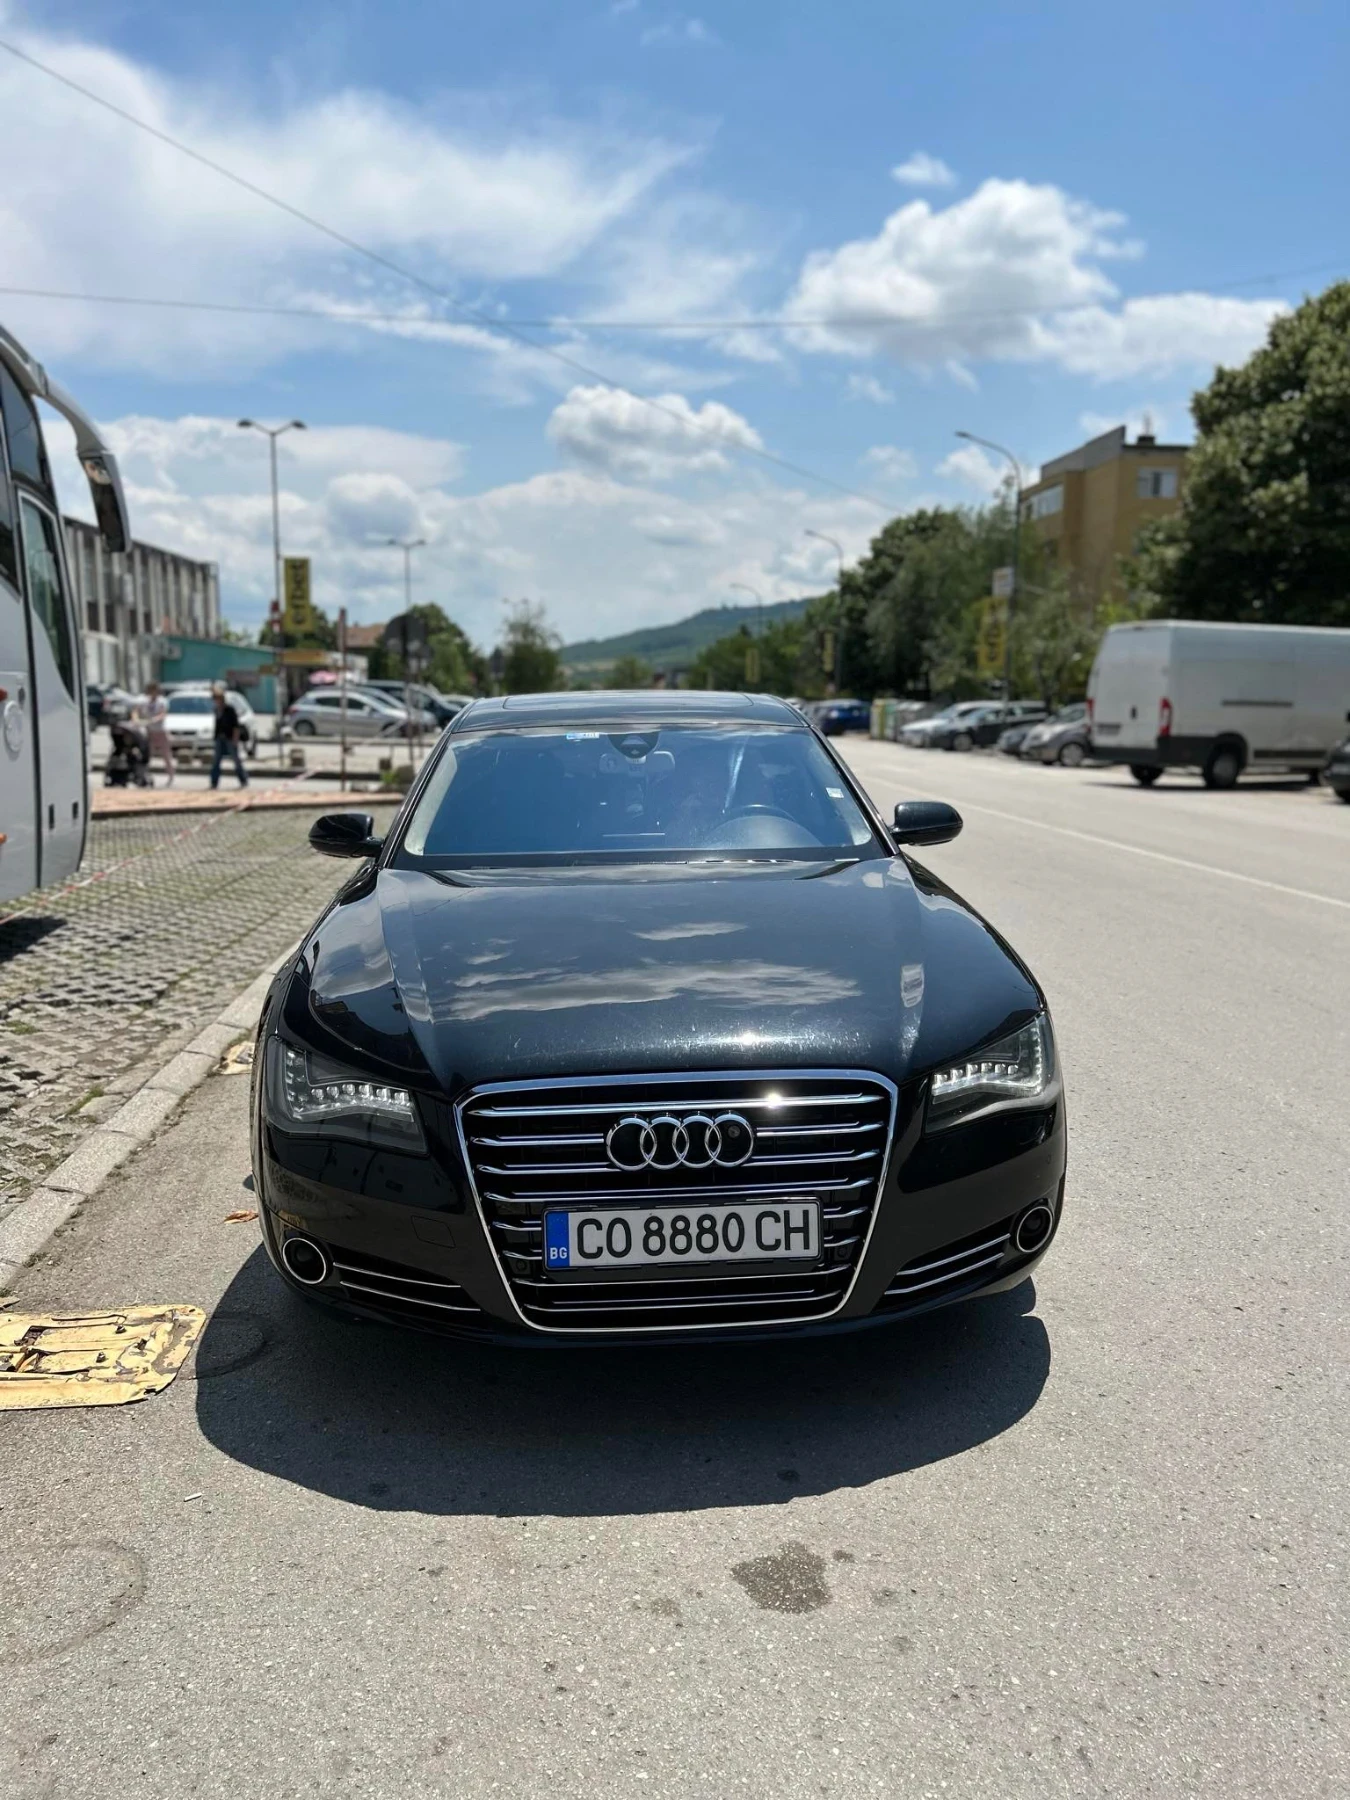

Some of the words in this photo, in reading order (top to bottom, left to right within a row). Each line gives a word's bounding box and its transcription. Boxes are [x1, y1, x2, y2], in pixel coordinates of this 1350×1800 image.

[577, 1217, 632, 1259] CO
[642, 1212, 745, 1256] 8880
[755, 1209, 809, 1252] CH
[550, 1247, 568, 1260] BG
